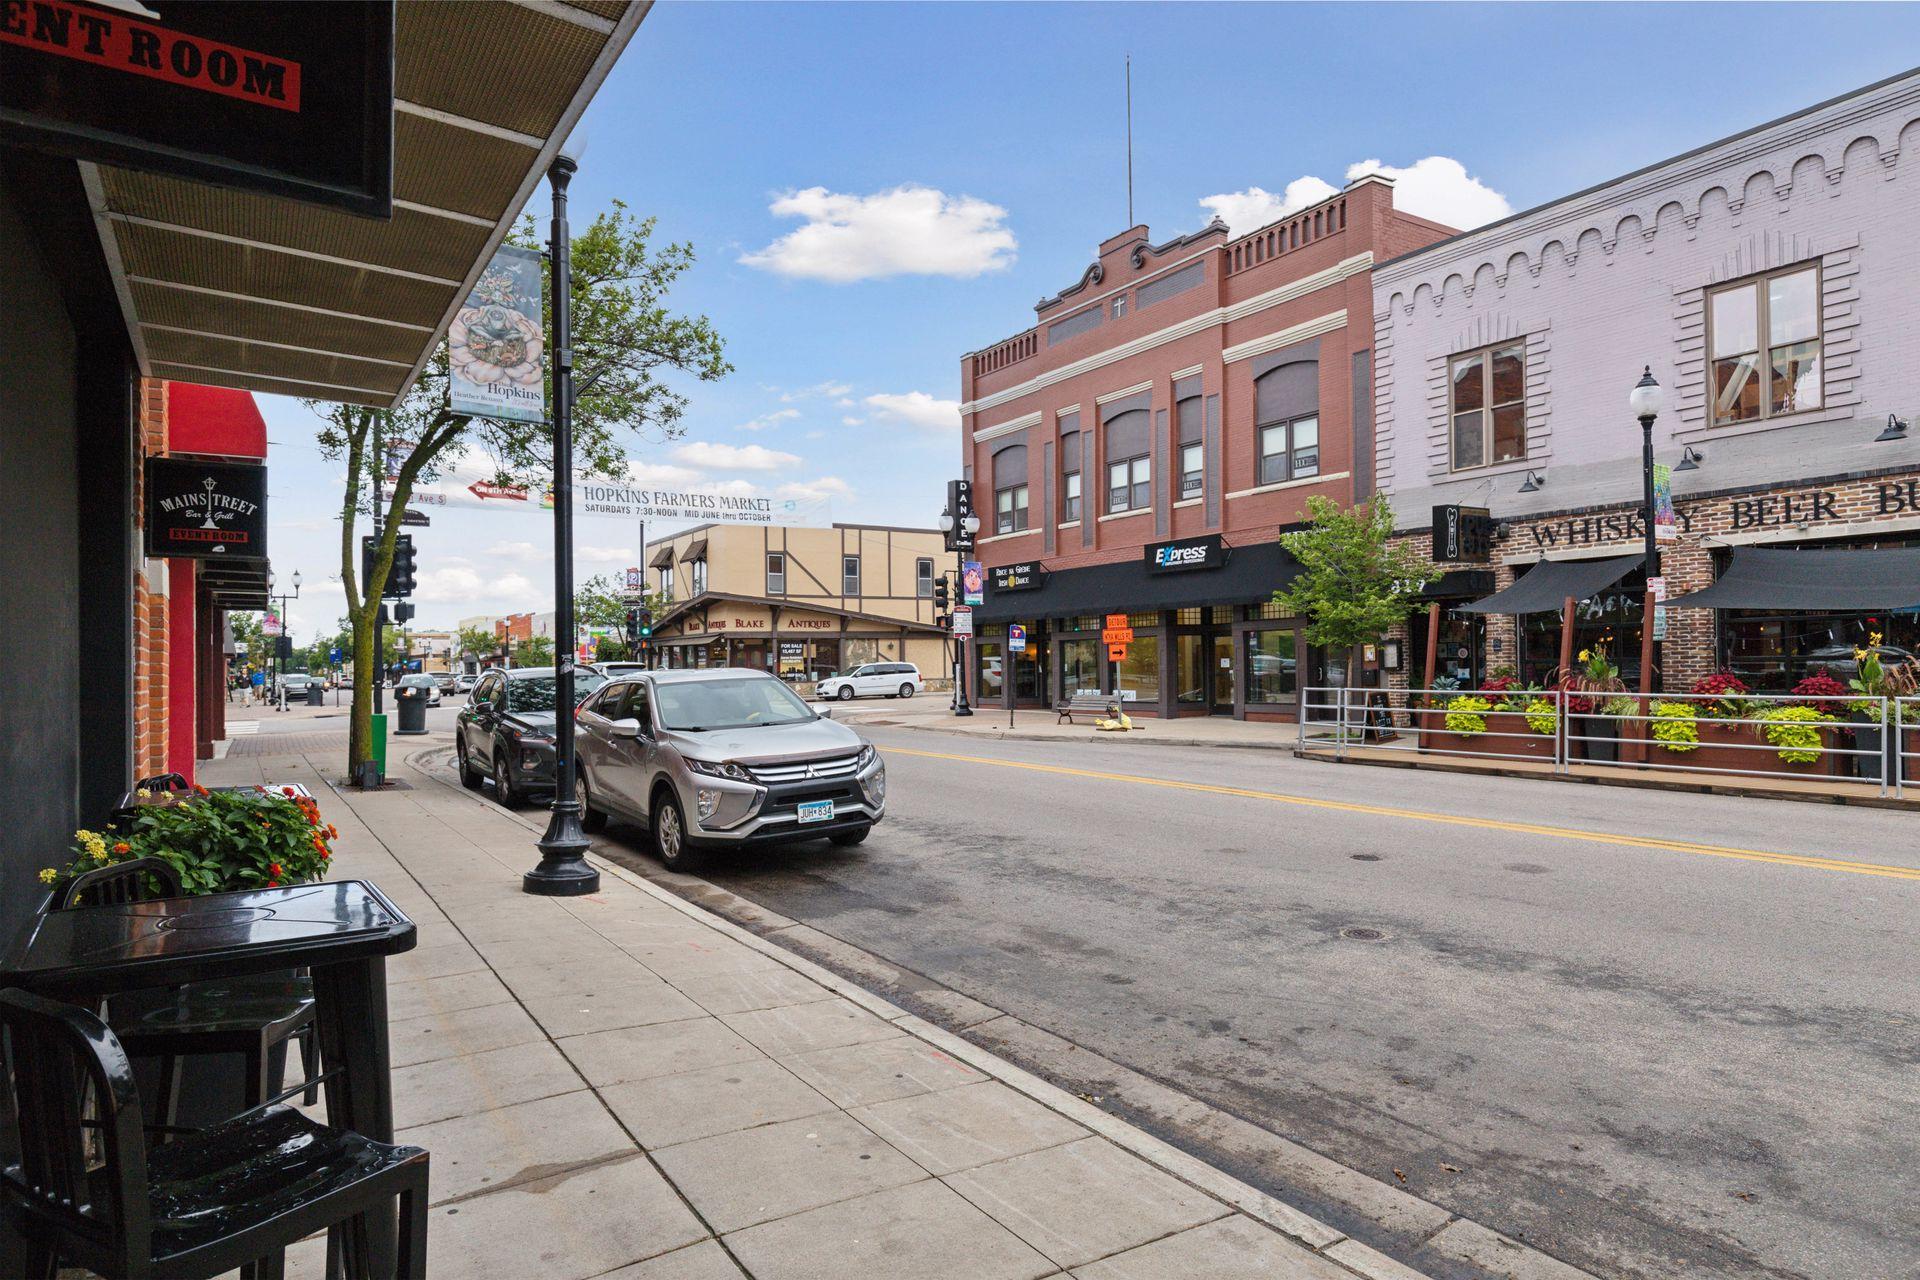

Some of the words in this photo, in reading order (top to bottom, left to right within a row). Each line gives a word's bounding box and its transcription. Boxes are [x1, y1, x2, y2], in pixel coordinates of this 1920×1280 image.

[128, 26, 286, 100] ROOM
[488, 383, 541, 400] Hopkins
[418, 494, 434, 503] Ave
[438, 495, 444, 504] S
[584, 486, 650, 504] HOPKINS
[654, 491, 715, 508] FARMERS
[719, 496, 771, 511] MARKET
[185, 509, 202, 518] Bar
[214, 511, 235, 521] Grill
[585, 503, 631, 514] SATURDAYS
[636, 506, 678, 517] 7:30-NOON
[684, 510, 699, 518] MID
[701, 511, 720, 519] JUNE
[722, 512, 736, 520] thru
[738, 513, 771, 521] OCTOBER
[1528, 506, 1700, 547] WHISKY
[1729, 491, 1842, 529] BEER
[172, 529, 209, 539] EVENT
[212, 531, 245, 541] ROOM
[735, 619, 764, 628] BLAKE
[788, 619, 831, 629] ANTIQUES
